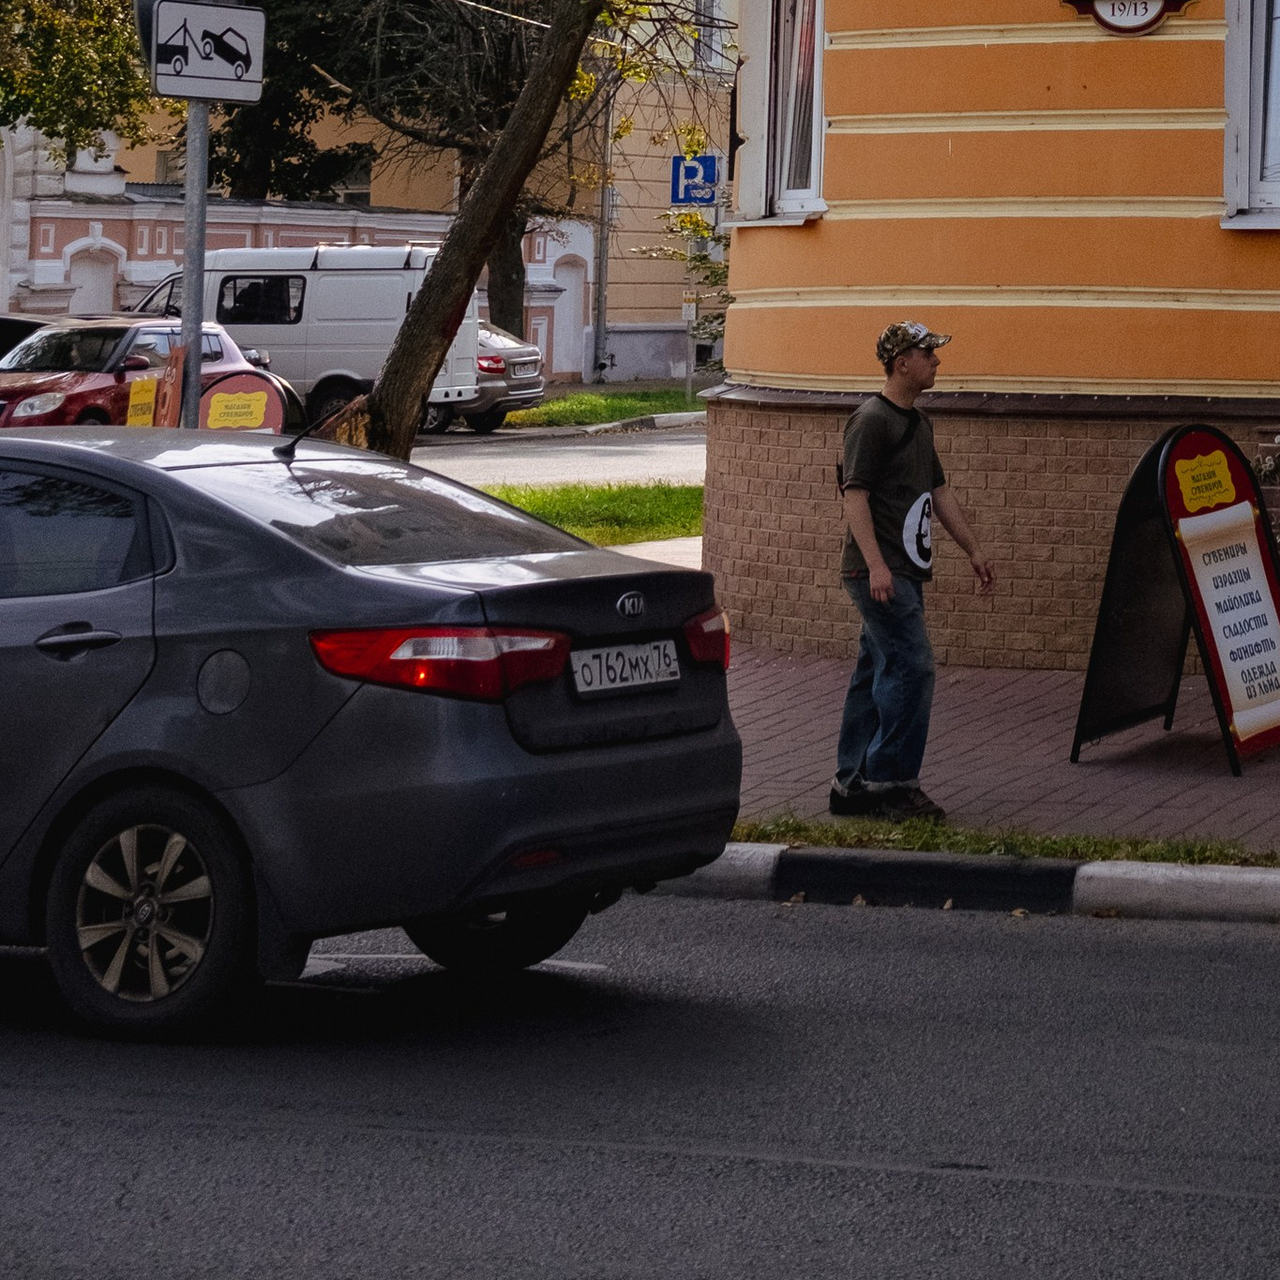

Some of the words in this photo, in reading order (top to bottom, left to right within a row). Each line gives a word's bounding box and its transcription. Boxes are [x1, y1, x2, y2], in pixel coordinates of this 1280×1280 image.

[1109, 1, 1149, 17] 19/13
[1202, 542, 1248, 566] СУВЕНИРЫ
[1212, 567, 1252, 589] ИЗРАЗЦЫ
[624, 597, 645, 615] KIA
[1214, 590, 1263, 615] МАЙОЛИКА
[1222, 613, 1269, 639] СЛАДОСТИ
[1229, 637, 1276, 663] ФИНИФТЬ
[1240, 661, 1278, 685] ОДЕЖДА
[1245, 685, 1257, 700] ИЗ
